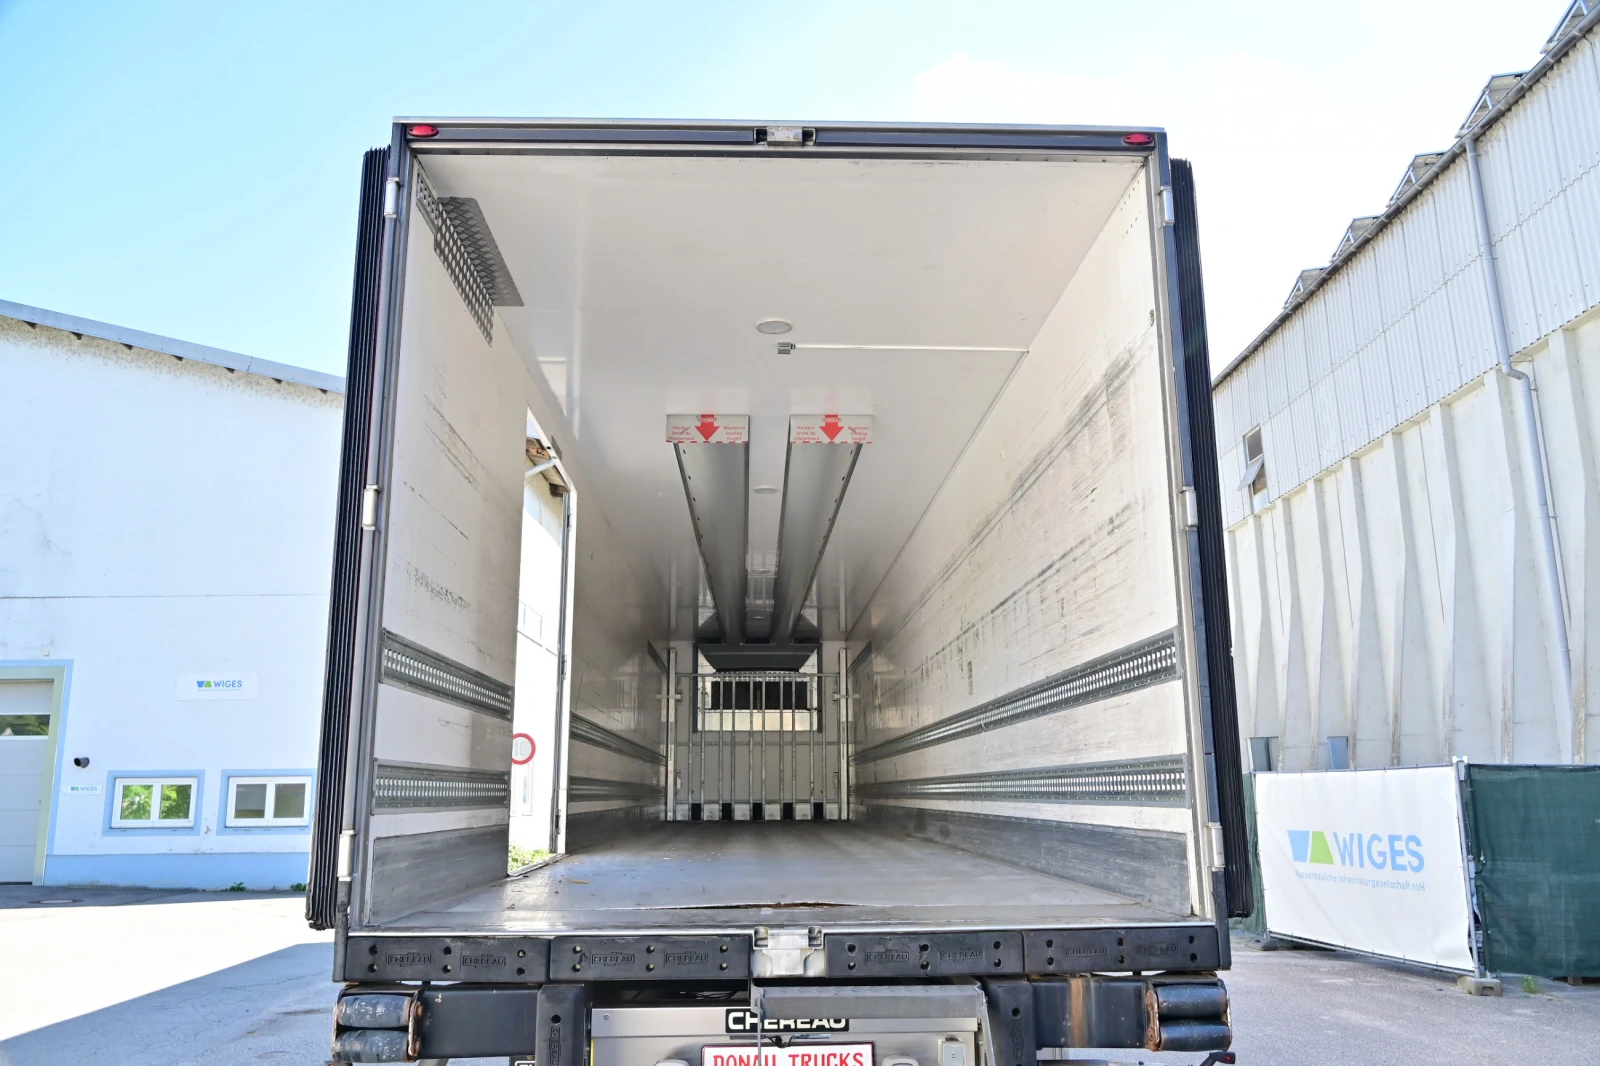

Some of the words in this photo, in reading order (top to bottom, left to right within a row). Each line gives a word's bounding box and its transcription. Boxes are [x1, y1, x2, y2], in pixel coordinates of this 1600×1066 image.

[213, 680, 243, 688] WIGES
[1332, 831, 1425, 873] WIGES
[389, 955, 430, 964] CHEREAU
[593, 955, 633, 963] CHEREAU
[667, 954, 707, 962] CHEREAU
[713, 1054, 776, 1066] DONU
[788, 1052, 864, 1066] TRUCKS
